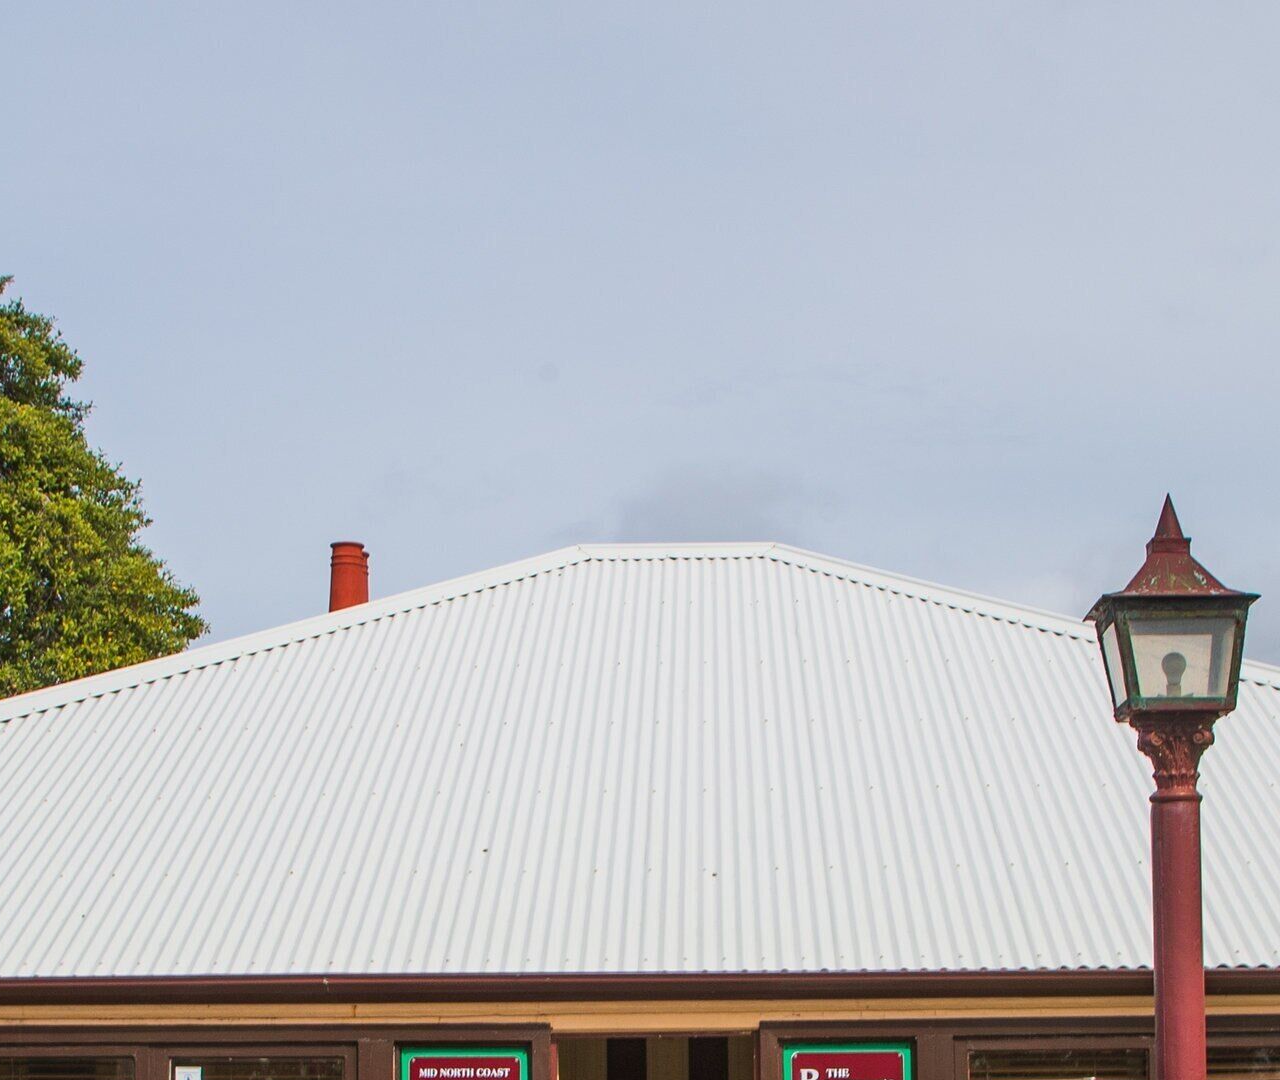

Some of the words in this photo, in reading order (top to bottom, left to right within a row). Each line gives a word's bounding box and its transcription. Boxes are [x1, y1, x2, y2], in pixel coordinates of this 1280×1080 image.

[419, 1068, 438, 1078] MID
[440, 1068, 474, 1078] NORTH
[476, 1068, 510, 1078] COAST
[826, 1068, 850, 1078] THE
